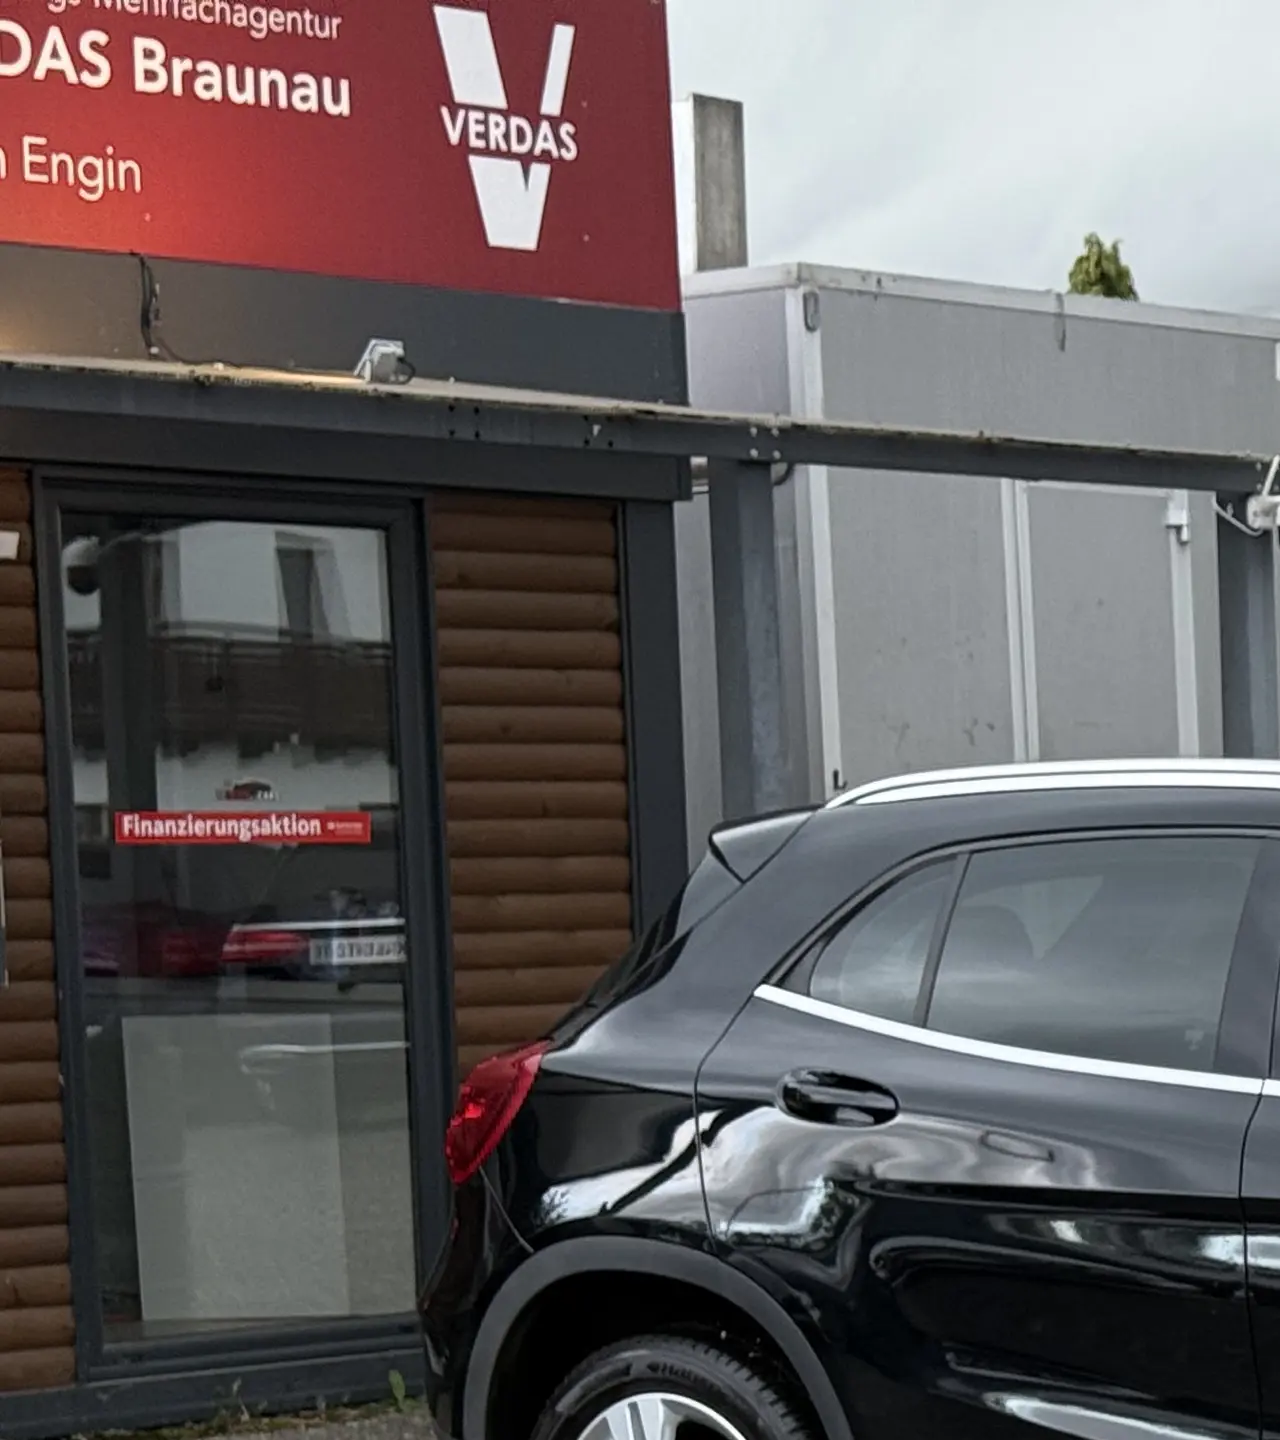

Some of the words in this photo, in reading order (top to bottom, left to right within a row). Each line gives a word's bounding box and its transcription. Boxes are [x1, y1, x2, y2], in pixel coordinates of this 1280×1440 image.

[133, 36, 351, 117] Braunau
[440, 105, 578, 161] VERDAS
[23, 135, 141, 201] Engin
[123, 813, 321, 842] Finanzierungsaktion
